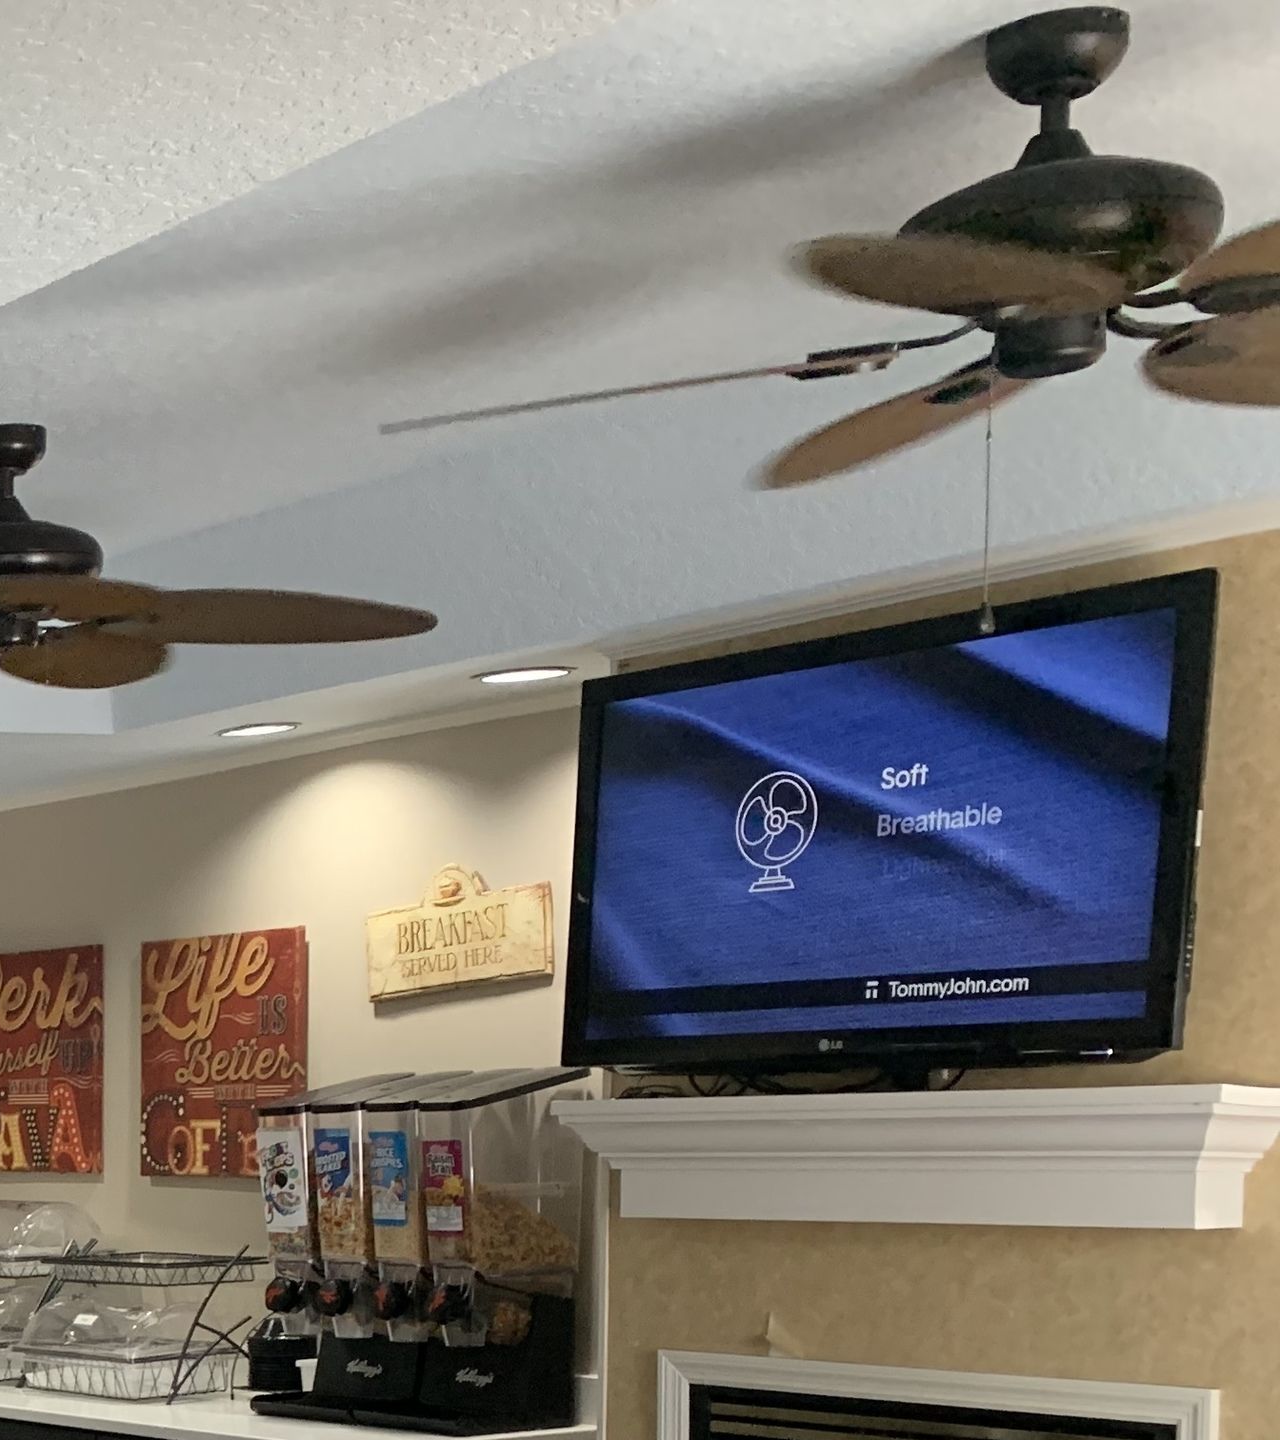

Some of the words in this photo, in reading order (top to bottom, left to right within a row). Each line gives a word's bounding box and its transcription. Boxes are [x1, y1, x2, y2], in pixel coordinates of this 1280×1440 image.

[880, 763, 929, 790] Soft
[877, 802, 1003, 837] Breathable
[397, 902, 508, 955] BREAKFAST
[401, 951, 457, 978] SERVED
[464, 944, 503, 969] HERE
[141, 933, 275, 1041] Life
[888, 977, 1030, 999] TommyJohn.com
[175, 1039, 306, 1084] Better
